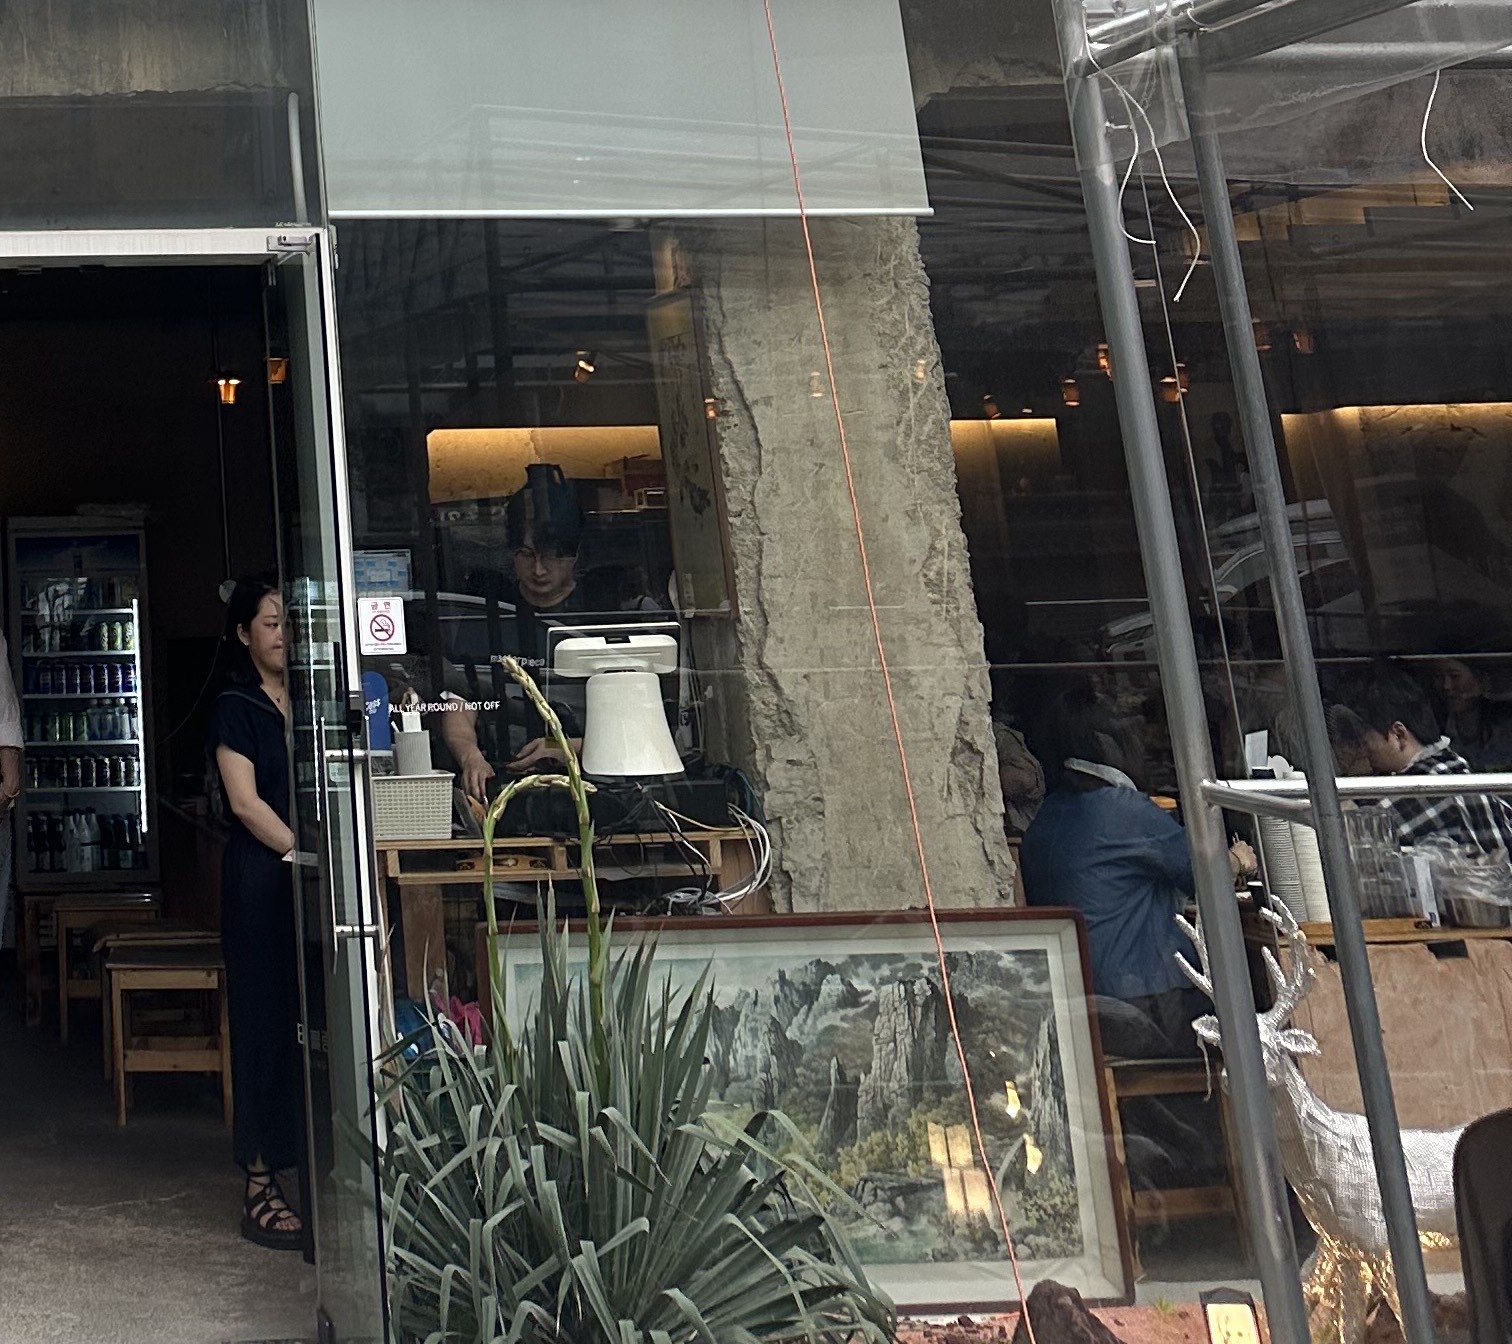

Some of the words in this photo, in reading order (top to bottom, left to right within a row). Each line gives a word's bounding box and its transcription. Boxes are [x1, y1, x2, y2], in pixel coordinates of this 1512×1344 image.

[389, 703, 405, 714] ALL
[405, 703, 426, 712] YEAR
[427, 702, 458, 712] ROUND
[484, 701, 500, 710] OFF
